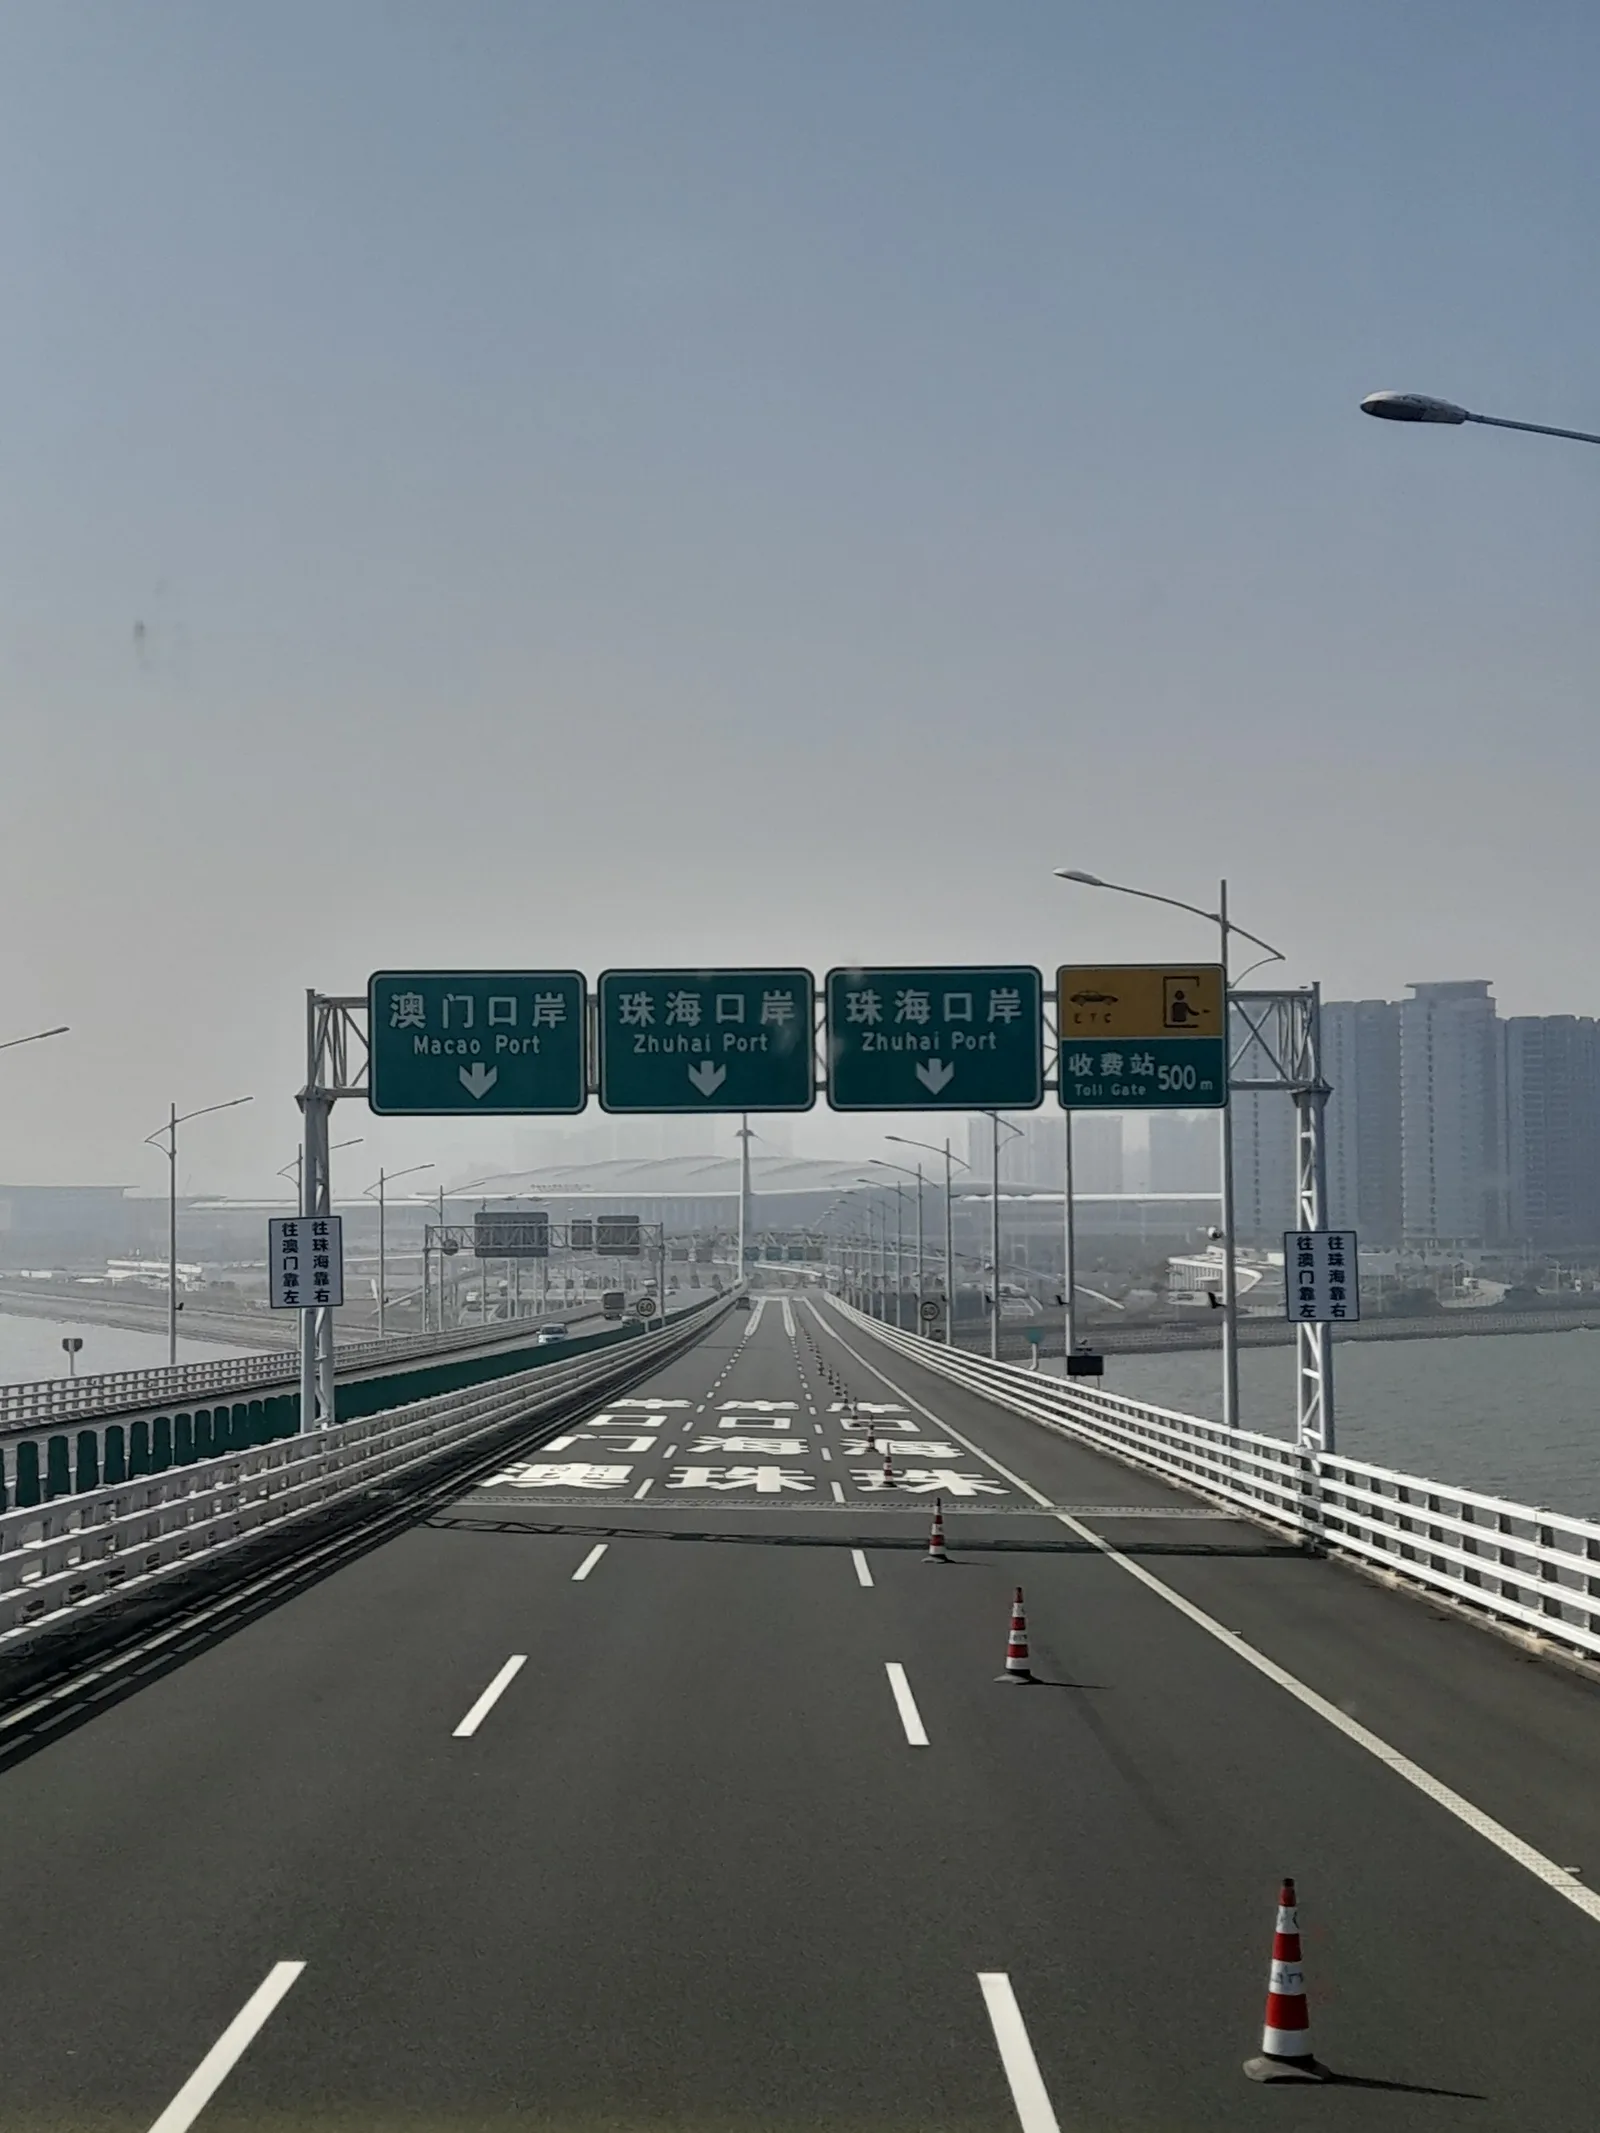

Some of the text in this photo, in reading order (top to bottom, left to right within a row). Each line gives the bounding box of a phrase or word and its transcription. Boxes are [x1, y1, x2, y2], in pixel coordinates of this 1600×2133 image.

[389, 992, 568, 1029] 澳门口岸
[619, 990, 796, 1027] 珠海口岸
[845, 988, 1023, 1025] 珠海口岸
[413, 1034, 541, 1055] Macao Port
[633, 1033, 769, 1053] Zhuhai Port
[861, 1031, 998, 1051] Zhuhai Port
[1068, 1052, 1155, 1077] 收费站
[1074, 1083, 1147, 1097] Toll Gate
[281, 1222, 300, 1305] 往澳门靠左
[312, 1221, 330, 1303] 往珠海靠右
[1297, 1236, 1316, 1318] 往澳门靠左
[1328, 1236, 1347, 1318] 往珠海靠右
